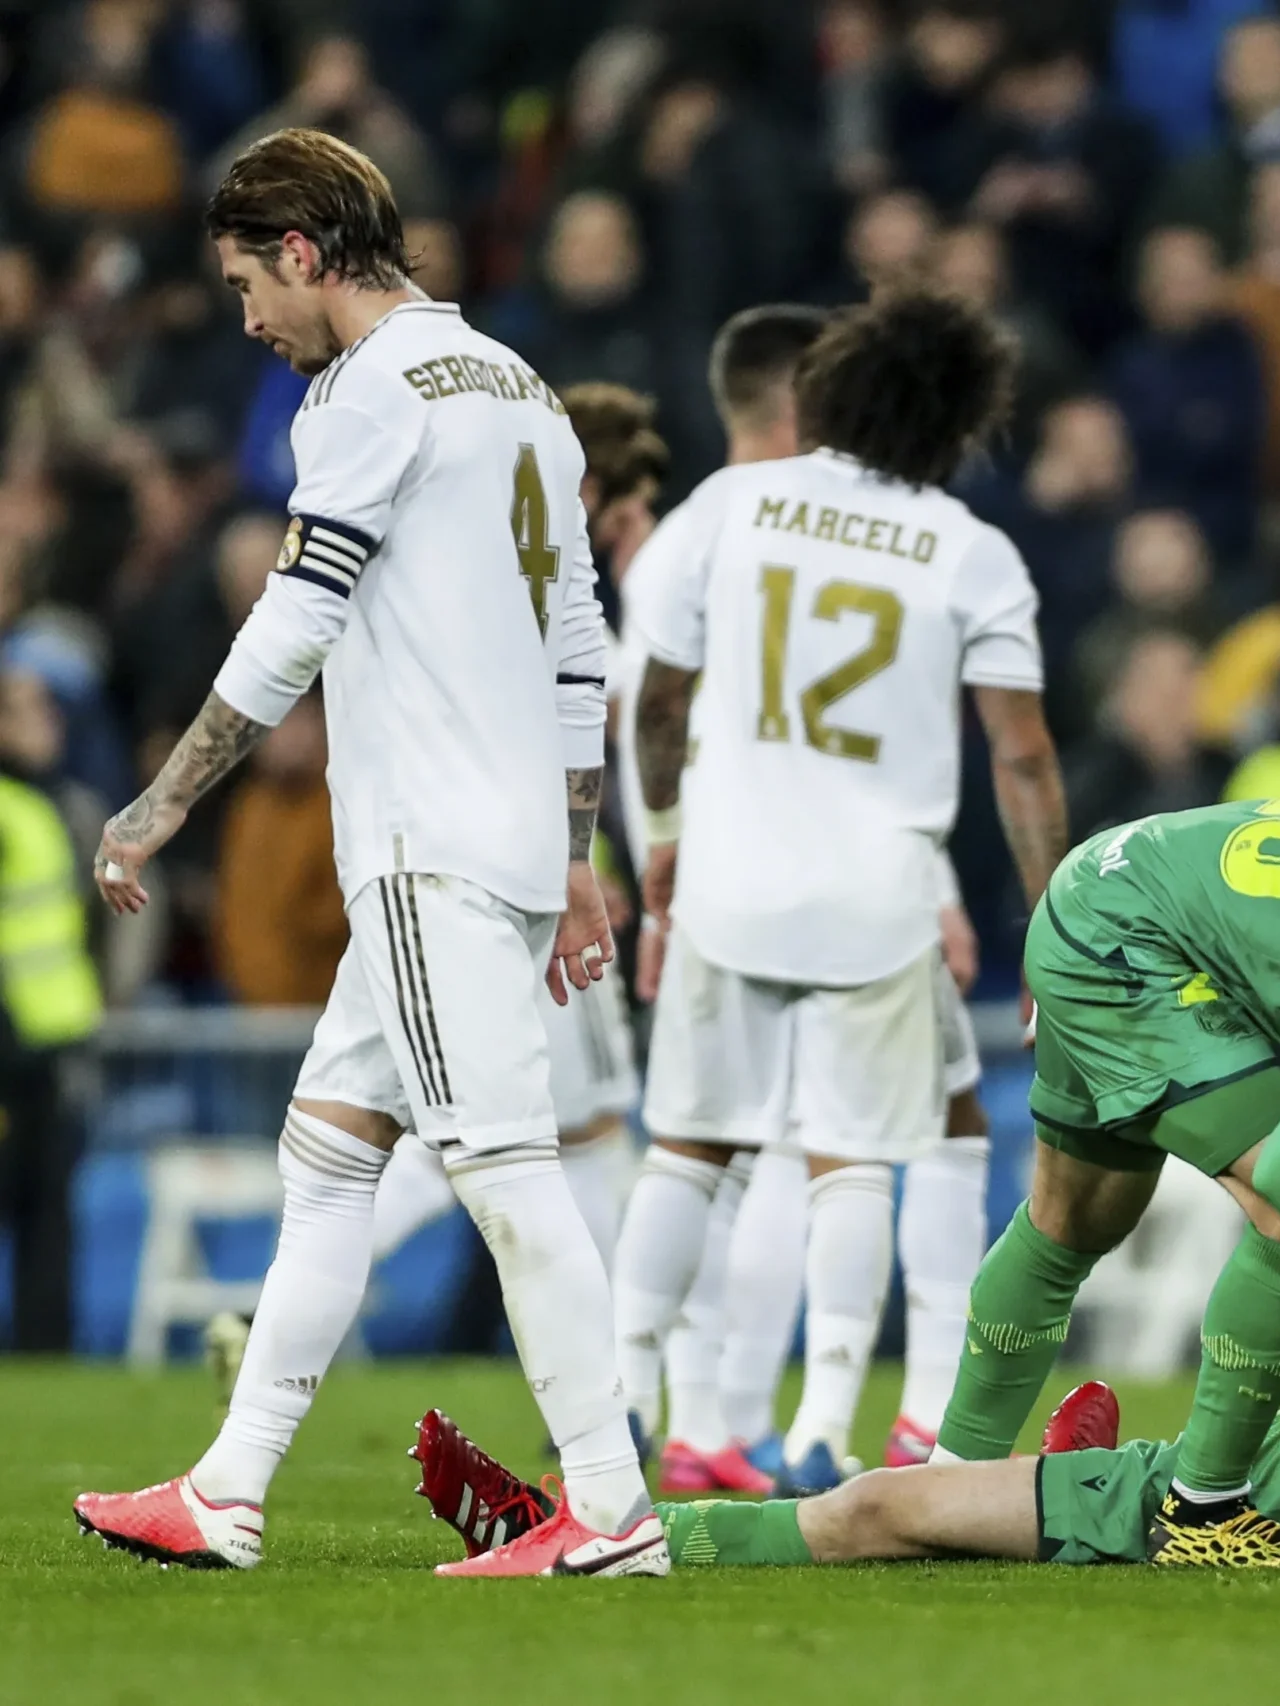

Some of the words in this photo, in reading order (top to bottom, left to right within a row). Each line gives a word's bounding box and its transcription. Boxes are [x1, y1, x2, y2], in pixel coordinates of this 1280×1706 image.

[402, 354, 498, 401] SERG
[510, 442, 560, 646] 4
[753, 496, 939, 564] MARCELO
[756, 561, 906, 764] 12
